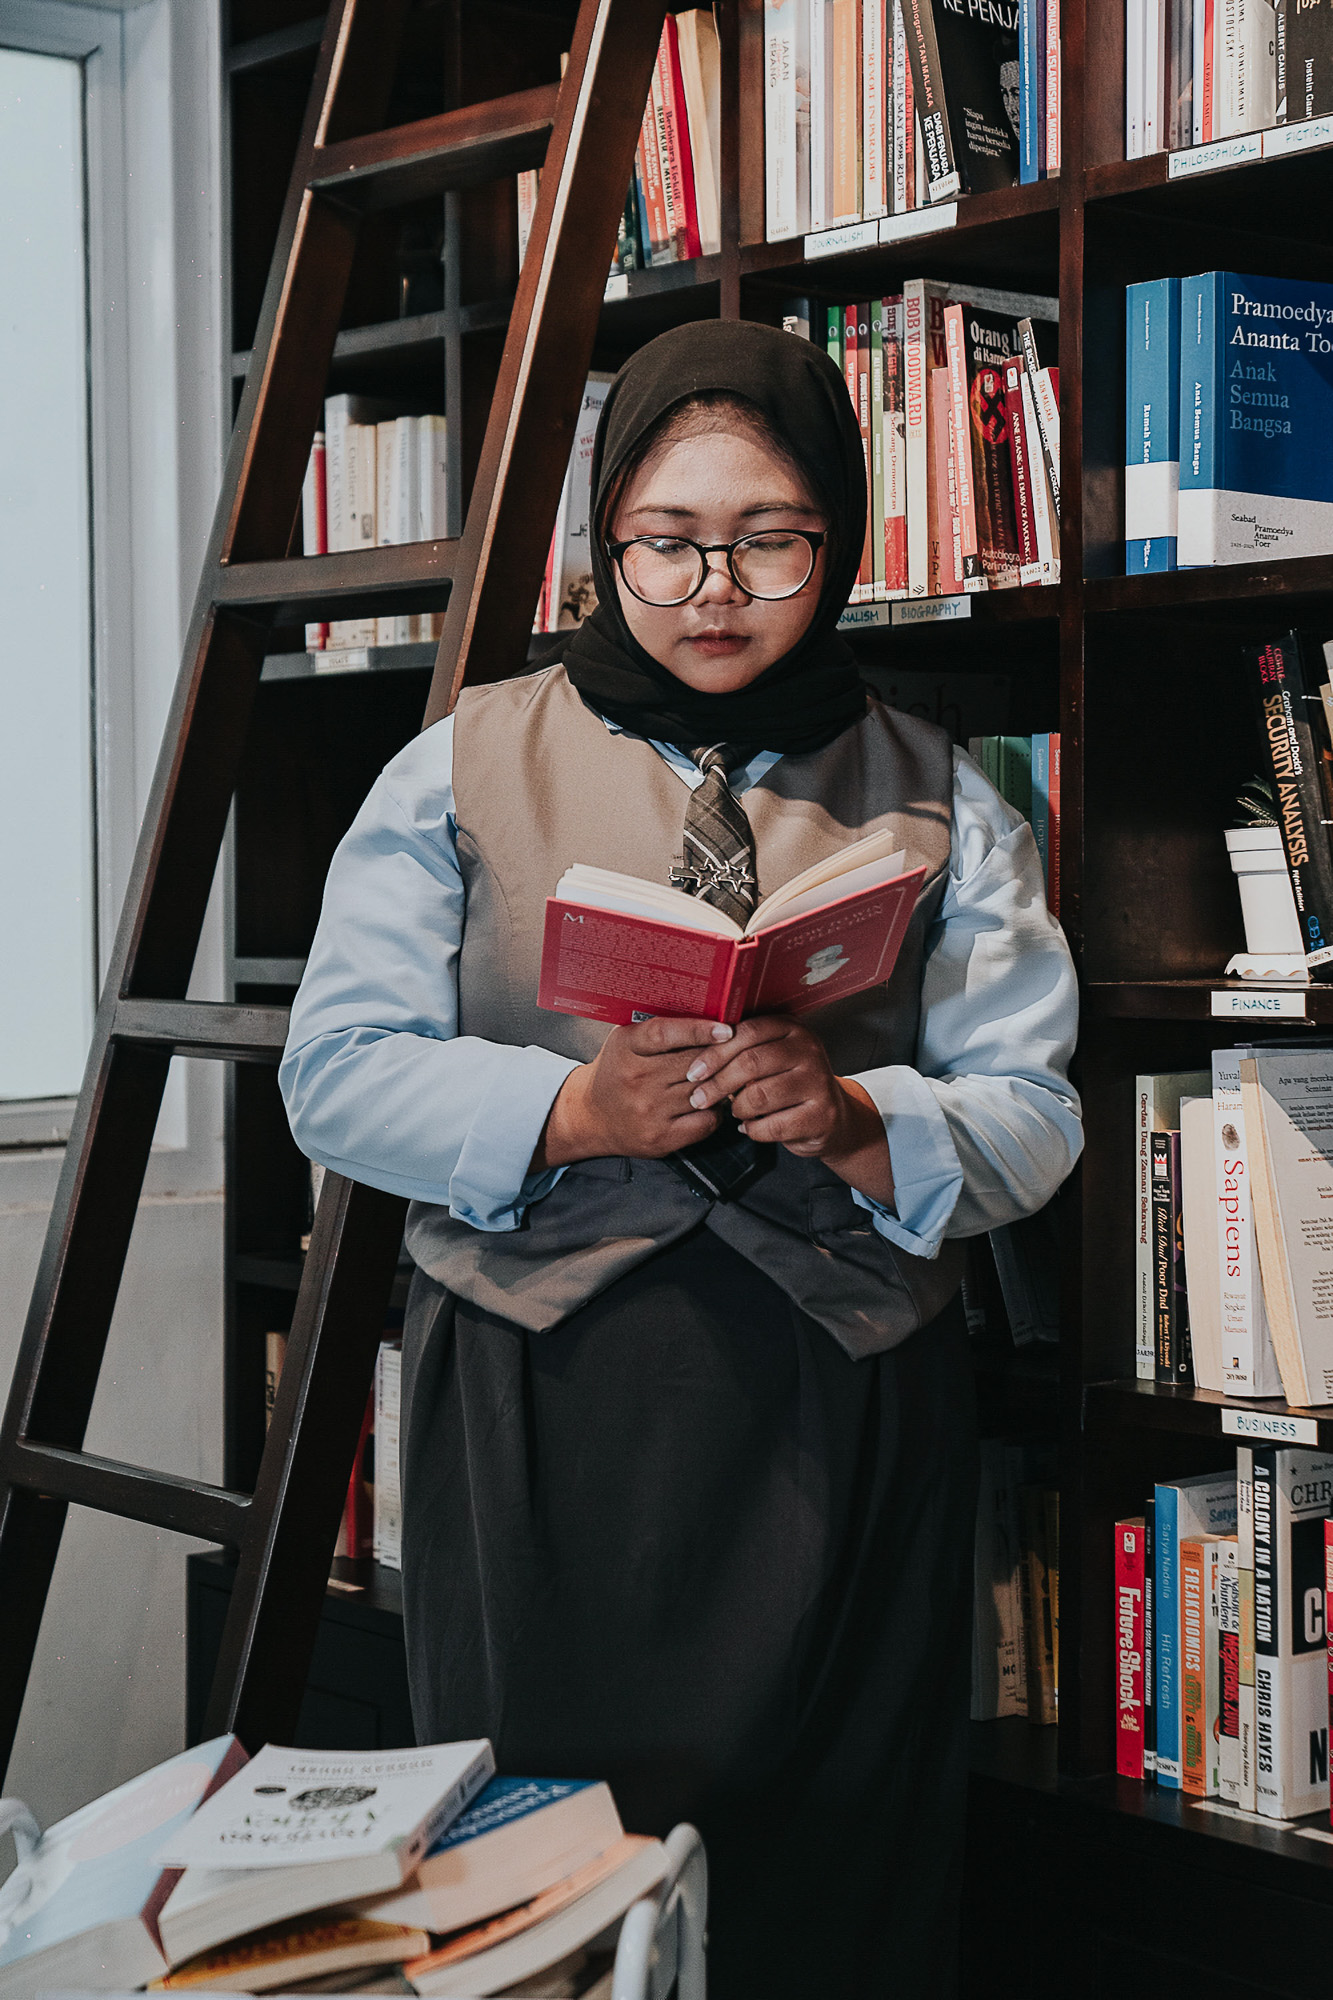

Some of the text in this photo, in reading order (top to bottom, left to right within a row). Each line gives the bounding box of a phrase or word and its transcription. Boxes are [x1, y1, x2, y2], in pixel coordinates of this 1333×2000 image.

[769, 38, 778, 88] TERANG
[782, 39, 790, 80] JALAN
[1277, 13, 1286, 90] ALBERT CAMUS
[918, 42, 934, 107] TAN MALAKA
[1305, 58, 1314, 92] Jostein
[867, 52, 876, 184] REVOLT IN PARADISE
[896, 53, 905, 201] OF THE MAY 1998 RIOTS
[932, 111, 945, 135] DARI
[1046, 54, 1058, 168] ISLAMISME, MARXISME
[924, 116, 941, 181] KE PENJARA
[1285, 122, 1330, 144] FICTION
[657, 105, 674, 212] BERPIKIR MENJADI
[665, 110, 681, 200] Berbicara Efektif
[936, 136, 950, 176] PENJARA
[1173, 142, 1257, 174] PHILOSOPHICAL
[812, 231, 864, 251] JOURNALISM
[1230, 292, 1333, 329] Pramoedya
[948, 318, 959, 347] Orang
[970, 320, 1010, 358] Orang
[1229, 325, 1333, 353] Ananta To
[905, 296, 923, 426] BOB WOODWARD
[949, 346, 962, 393] Indonesia
[973, 346, 982, 362] di
[1229, 359, 1277, 382] Anak
[859, 401, 868, 428] DEKKER
[1021, 331, 1032, 347] THE
[1048, 466, 1060, 496] GEORGE
[1037, 380, 1054, 422] TAN MALAKA
[1229, 383, 1290, 409] Semua
[954, 402, 965, 429] Kamp
[1011, 411, 1021, 434] ANNE
[1143, 404, 1151, 462] Rumah Kaca
[1192, 382, 1202, 475] Anak Semua Bangsa
[1229, 409, 1293, 439] Bangsa
[888, 416, 897, 453] Seorang
[956, 428, 969, 483] Konsentrasi
[1016, 465, 1025, 481] THE
[347, 447, 357, 507] Outliers
[889, 455, 897, 510] Demonstran
[960, 484, 970, 506] NAZI
[1017, 481, 1028, 507] DIARY
[1230, 513, 1257, 524] Seabad
[1253, 532, 1279, 541] Ananta
[1254, 524, 1294, 537] Pramoedya
[952, 517, 963, 582] BOB WOODWARD
[1253, 539, 1271, 548] Toer
[900, 601, 961, 620] BIOGRAPHY
[1257, 655, 1269, 685] BLOCK
[1264, 644, 1278, 681] MURRAY
[1281, 690, 1303, 775] Graham and Dodd's
[1262, 694, 1309, 867] SECURITY ANALYSIS
[1294, 885, 1305, 912] Edition
[1231, 996, 1281, 1012] FINANCE
[1218, 1070, 1240, 1081] Yuval
[1218, 1086, 1241, 1095] Noah
[1139, 1093, 1149, 1244] Cerdas Uang Zaman Sekarang
[1157, 1206, 1168, 1233] Rich
[1218, 1158, 1245, 1277] Sapiens
[1157, 1261, 1168, 1286] Poor
[1158, 1288, 1169, 1310] Dad
[1163, 1341, 1171, 1368] Kiyosaki
[1236, 1416, 1297, 1437] BUSINESS
[1254, 1465, 1272, 1642] A COLONY IN A NATION
[1161, 1522, 1173, 1709] Satya Nadella Hit Refresh
[1184, 1567, 1202, 1671] FREAKONOMICS
[1219, 1574, 1232, 1629] Aburdene
[1118, 1586, 1141, 1712] Future Shock
[1185, 1674, 1196, 1714] LEVITT
[1219, 1633, 1240, 1735] Megatrends 2000
[1257, 1668, 1273, 1773] CHRIS HAYES
[1186, 1724, 1197, 1768] DUBNER
